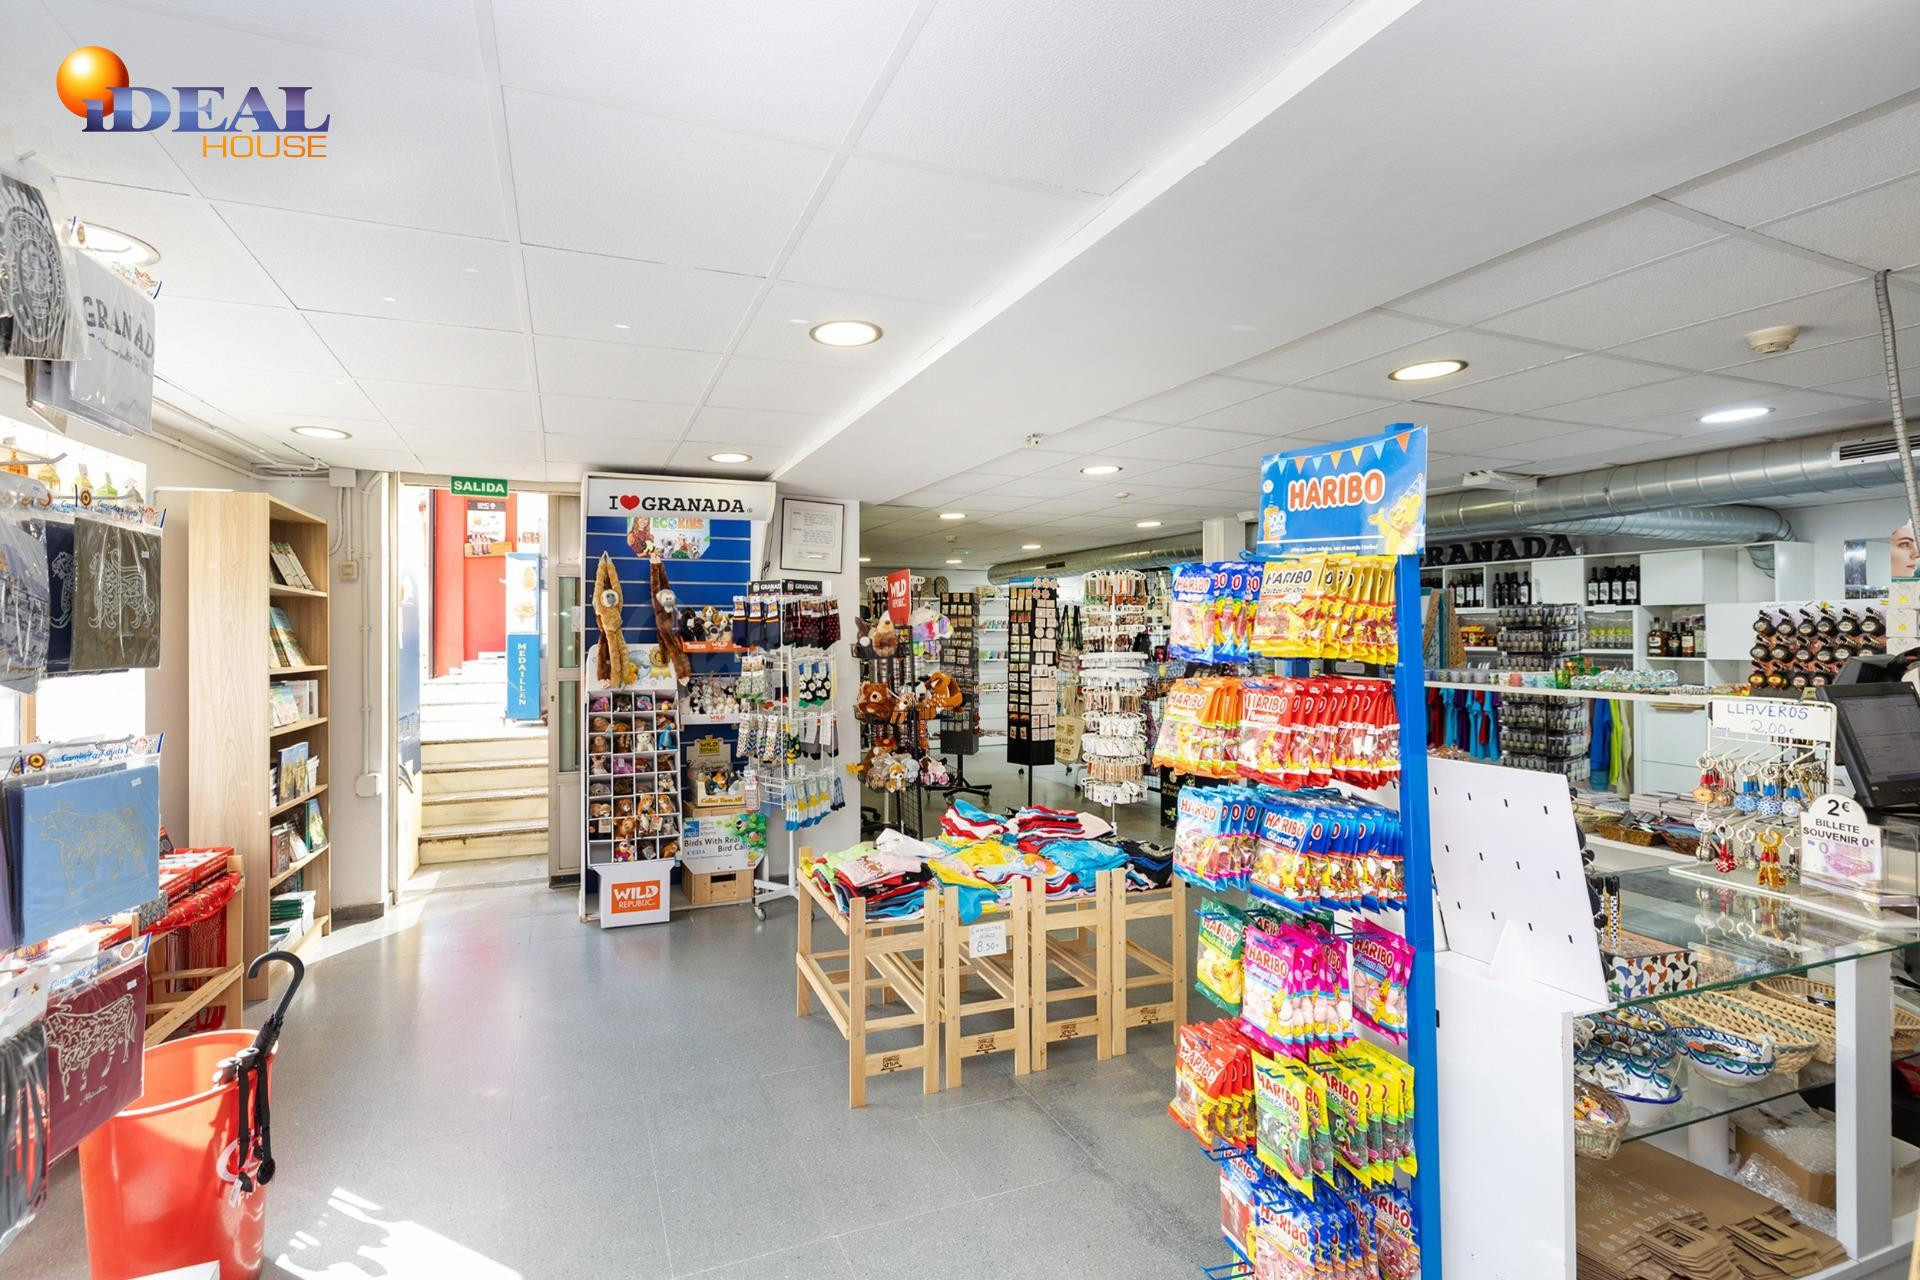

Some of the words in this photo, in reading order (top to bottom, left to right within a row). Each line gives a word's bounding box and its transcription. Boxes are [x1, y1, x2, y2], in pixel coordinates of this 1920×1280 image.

[82, 295, 154, 358] GRANAD
[453, 480, 505, 493] SALIDA
[1288, 469, 1385, 511] HARIBO
[608, 495, 619, 510] I
[641, 496, 745, 513] GRANADA
[1422, 534, 1577, 567] RANADA
[1175, 576, 1210, 593] HARIBO
[1265, 569, 1313, 585] HARIBO
[760, 582, 781, 591] GRANAD
[795, 583, 819, 591] GRANADA
[517, 643, 527, 706] MEDAILLEN
[1169, 692, 1206, 708] HARIBO
[1245, 693, 1288, 714] HARIBO
[1727, 703, 1808, 720] LLAVEROS
[1180, 798, 1217, 821] HARIBO
[1265, 812, 1307, 838] HARIBO
[1815, 818, 1860, 835] BILLETE
[684, 839, 703, 847] Birds
[725, 836, 740, 844] Real
[1802, 826, 1859, 846] SOUVENIR
[718, 845, 733, 853] Bird
[734, 843, 752, 851] Calls
[613, 885, 659, 901] WILD
[1247, 943, 1289, 979] HARIBO
[1353, 938, 1395, 969] HARIBO
[1257, 1071, 1300, 1112] HARIBO
[1321, 1071, 1360, 1107] ARIBO
[1394, 1223, 1411, 1240] PIKA
